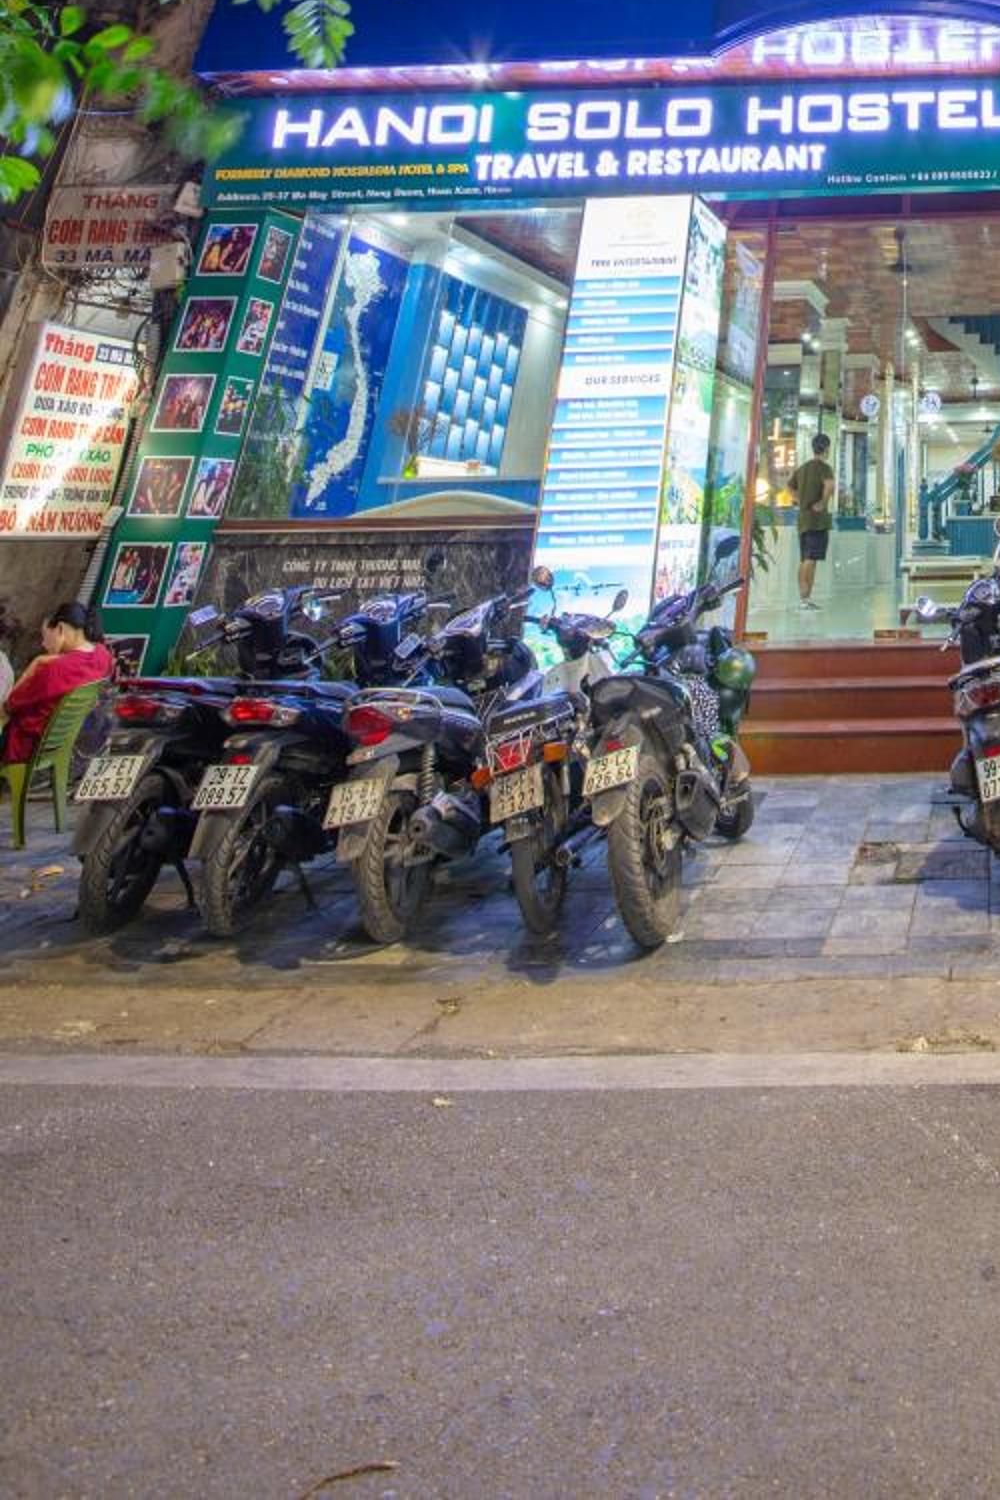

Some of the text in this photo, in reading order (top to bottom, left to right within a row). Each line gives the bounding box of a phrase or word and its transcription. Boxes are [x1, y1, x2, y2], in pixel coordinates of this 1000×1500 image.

[271, 104, 495, 150] HANOI
[526, 96, 714, 142] SOLO
[475, 143, 827, 182] TRAVEL & RESTAURANT
